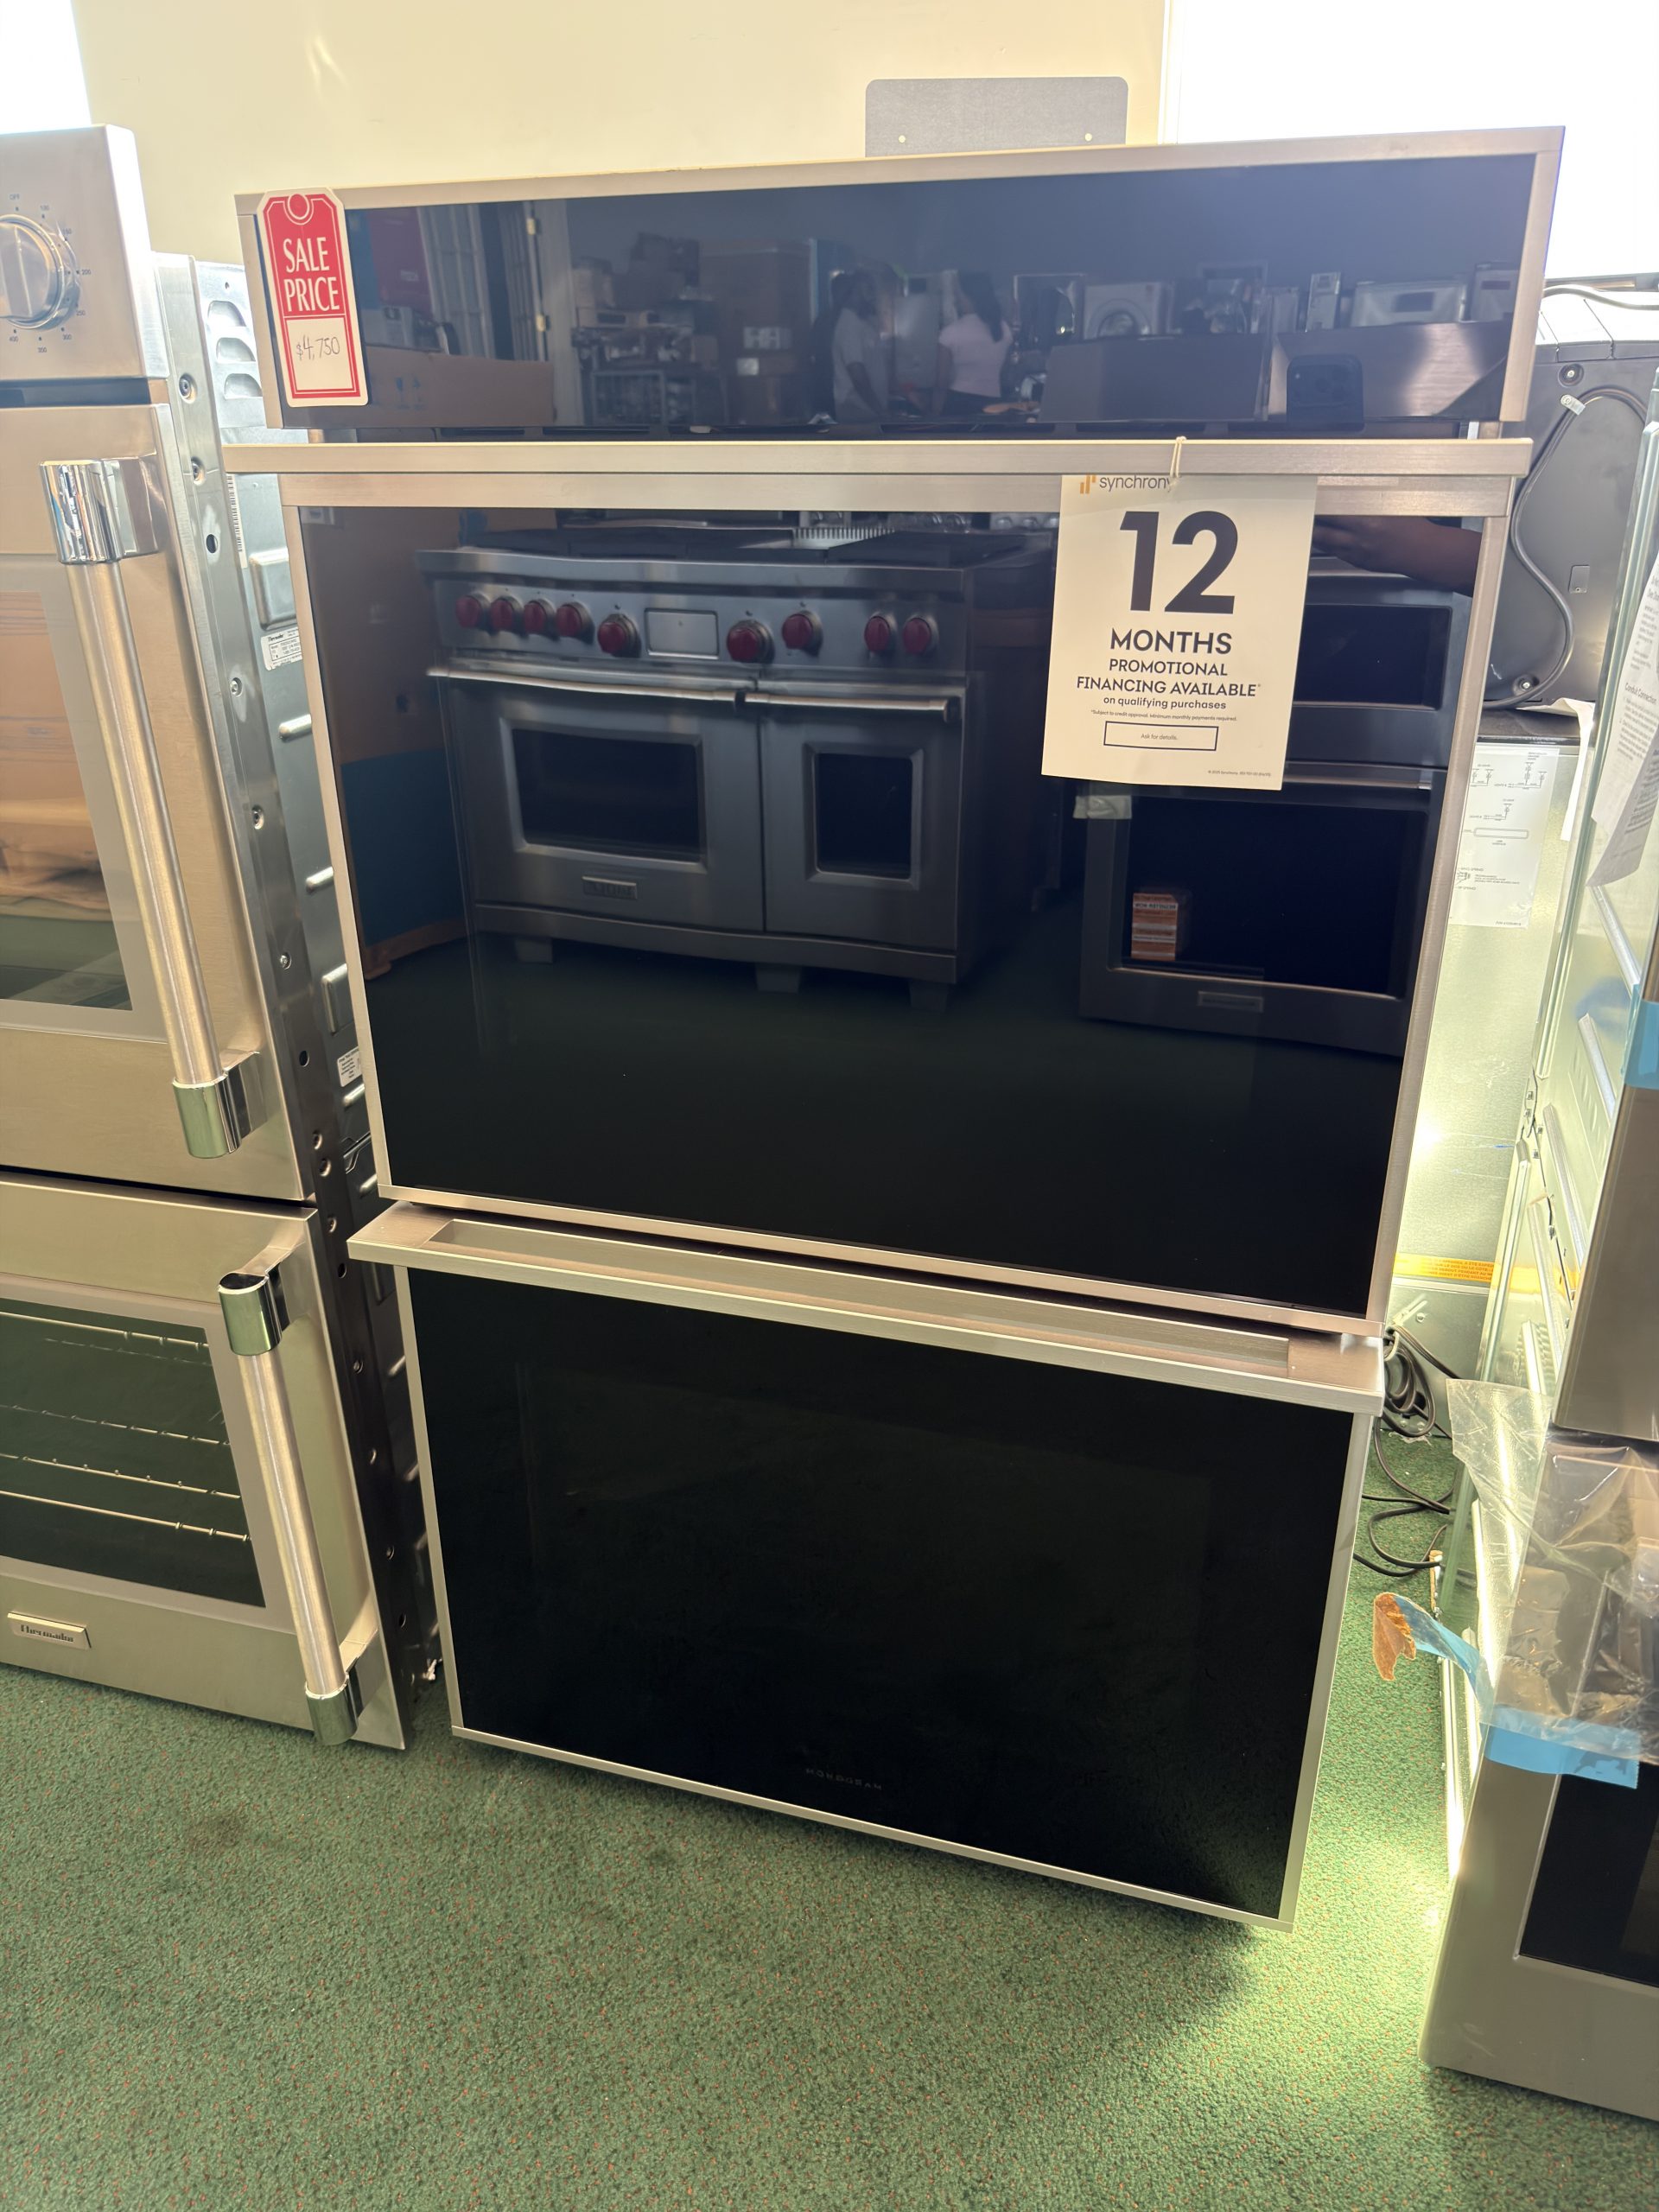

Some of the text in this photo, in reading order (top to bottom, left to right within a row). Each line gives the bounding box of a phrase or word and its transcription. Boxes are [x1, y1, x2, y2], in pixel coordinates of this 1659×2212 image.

[283, 237, 330, 273] SALE
[283, 276, 340, 313] PRICE
[296, 334, 341, 361] $4,750
[1120, 510, 1239, 615] 12
[1110, 627, 1232, 655] MONTHS
[1109, 658, 1229, 677] PROMOTIONAL
[1077, 676, 1166, 694] FINANCING
[1103, 696, 1227, 710] on qualifying purchases
